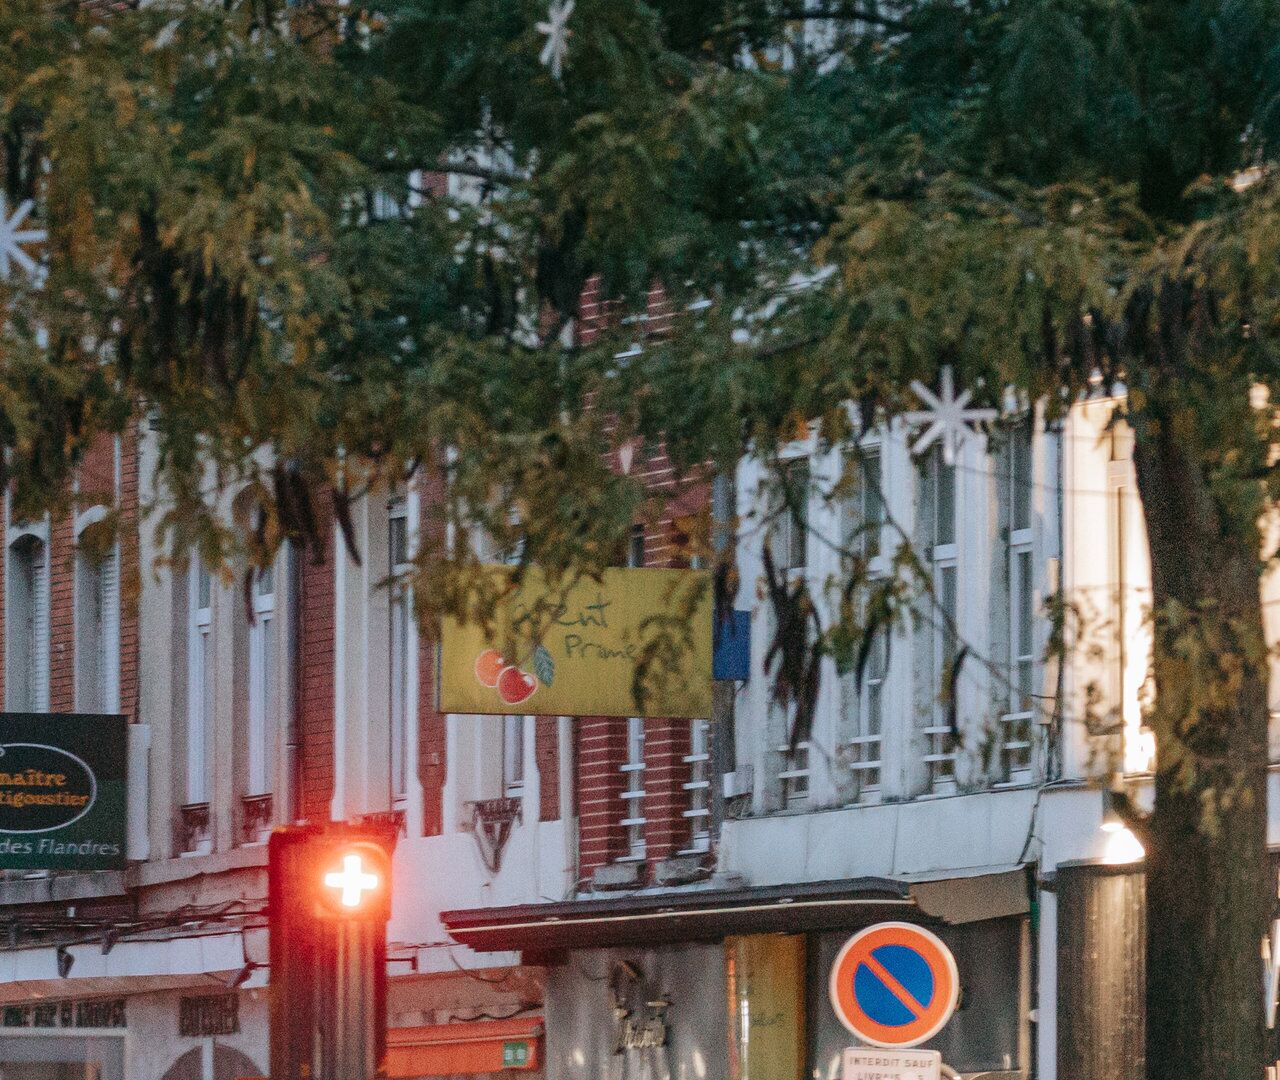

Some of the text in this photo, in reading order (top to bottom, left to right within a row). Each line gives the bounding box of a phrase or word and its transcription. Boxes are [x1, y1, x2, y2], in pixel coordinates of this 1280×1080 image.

[39, 838, 119, 856] Flandres
[849, 1057, 934, 1068] INTERDIT SAUF
